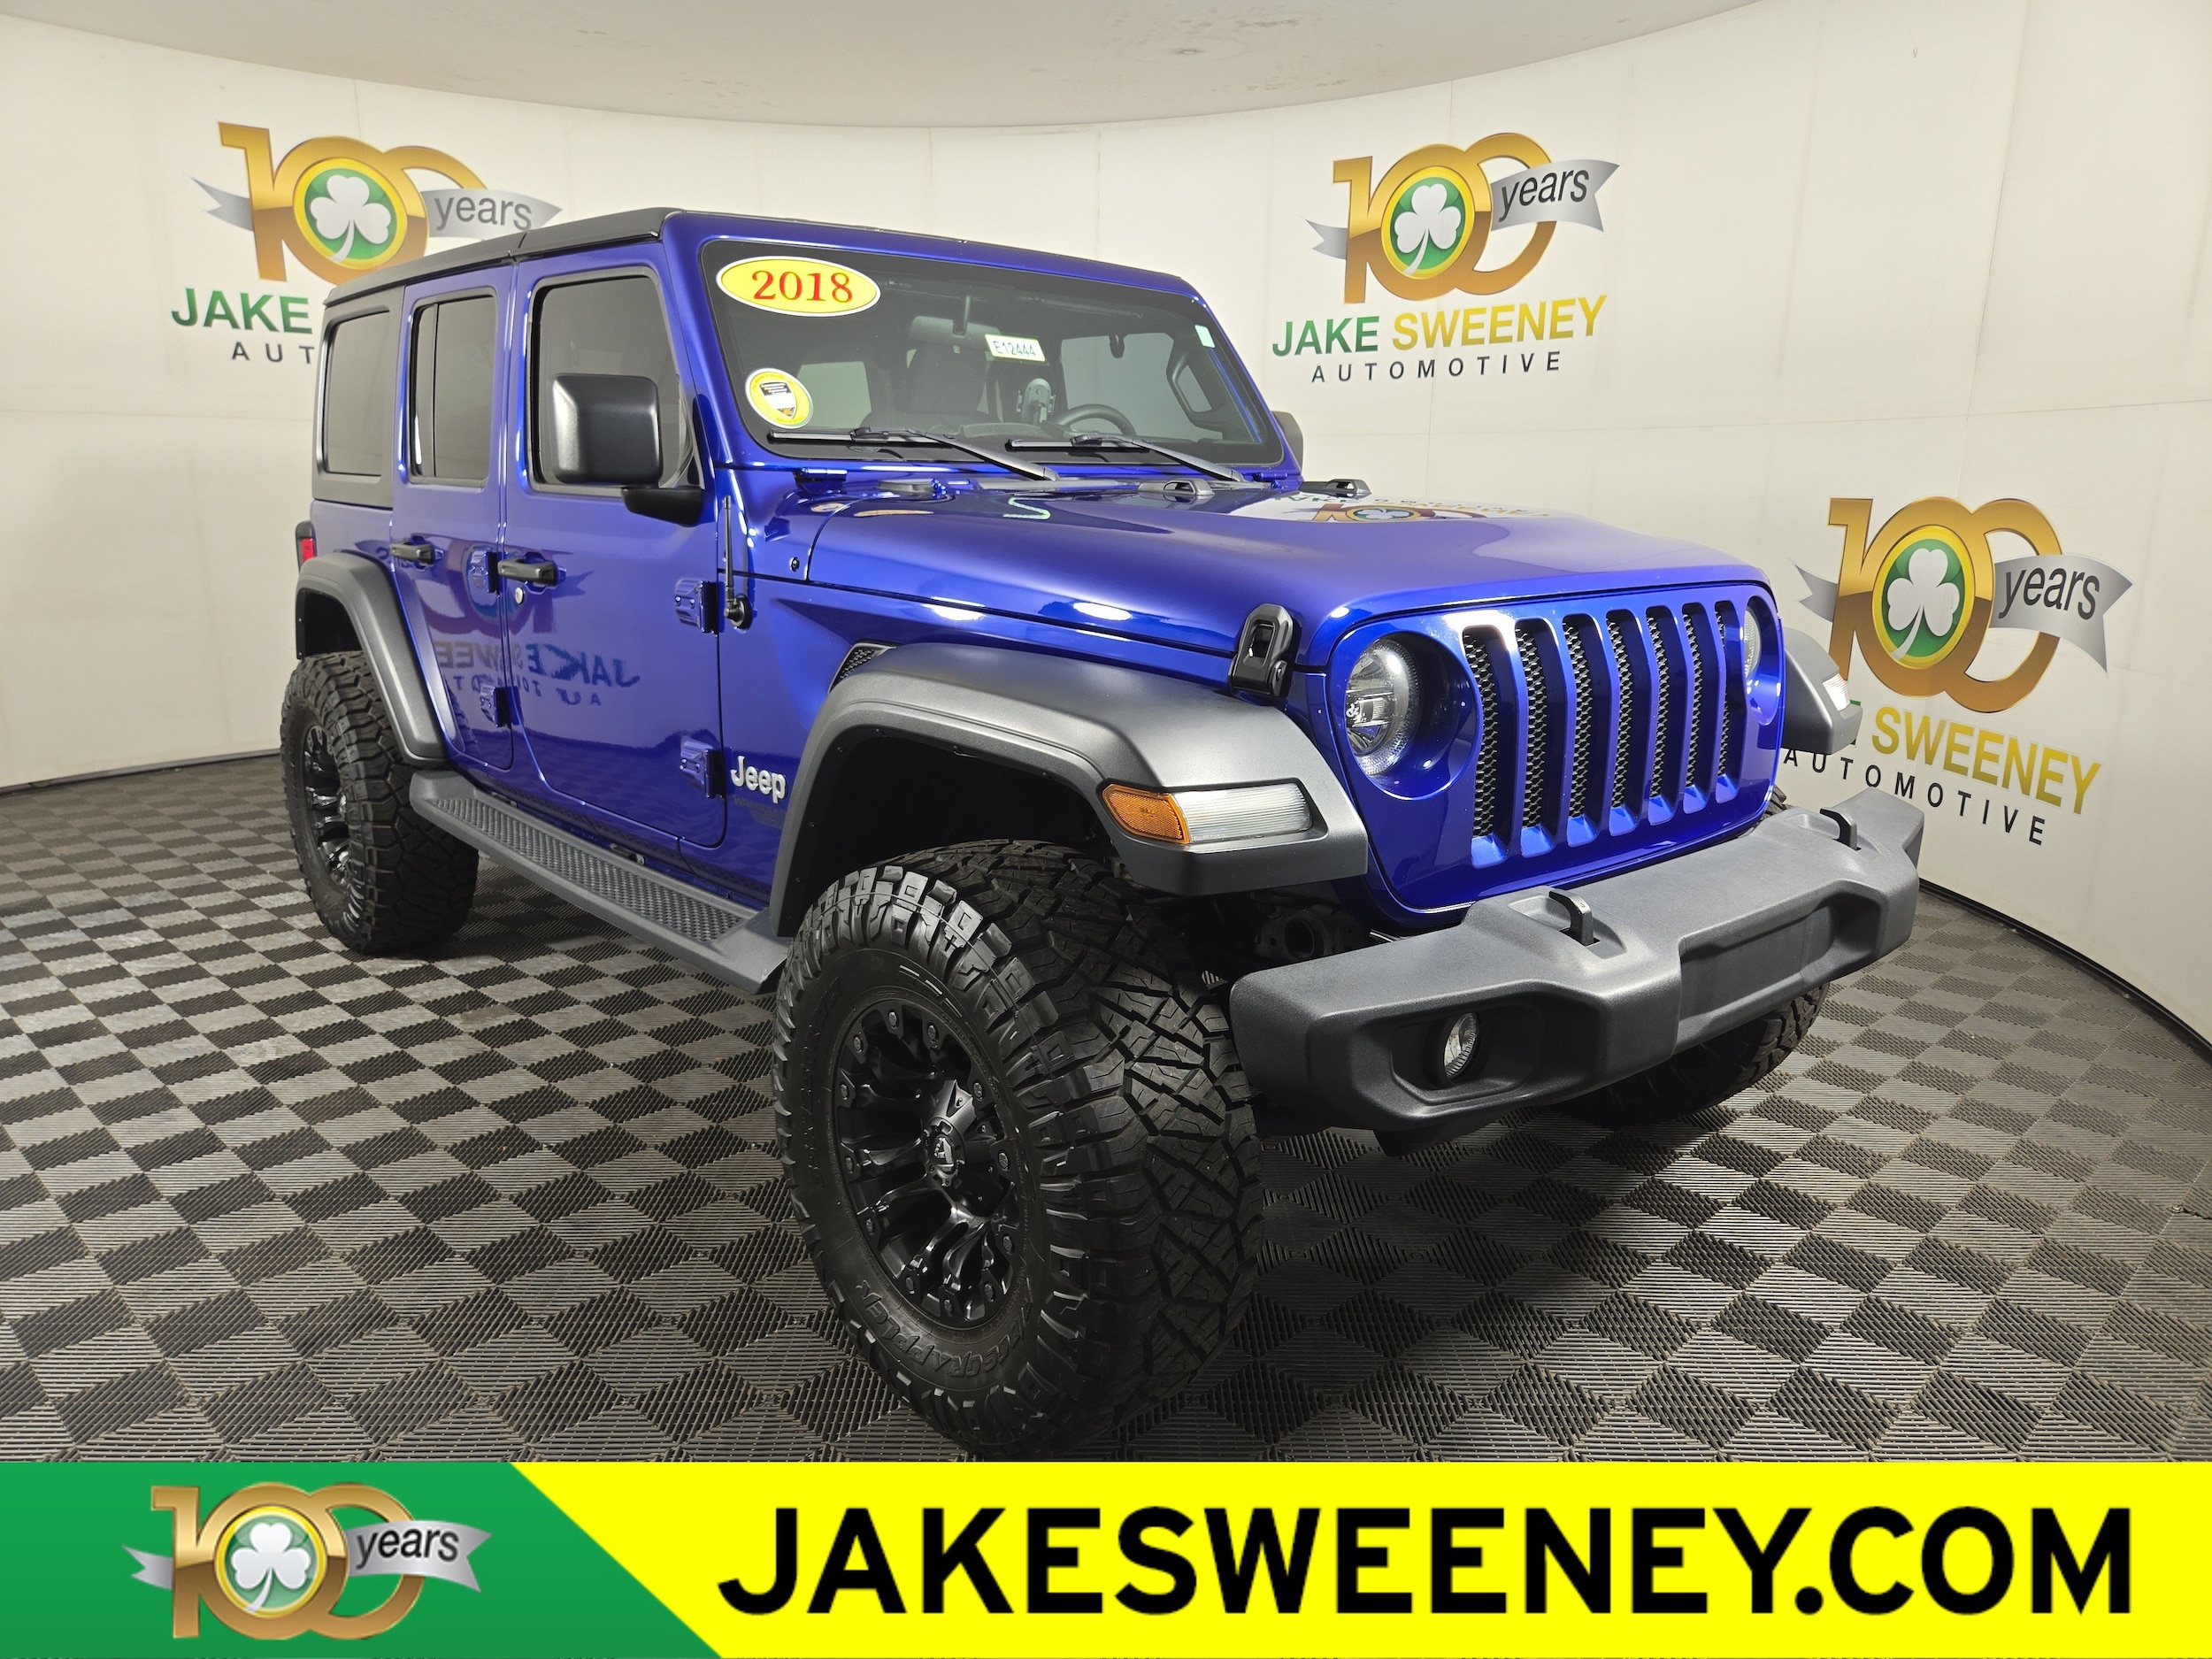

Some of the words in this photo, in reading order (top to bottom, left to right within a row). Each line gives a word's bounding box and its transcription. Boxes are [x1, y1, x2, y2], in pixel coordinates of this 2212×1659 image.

[434, 190, 532, 232] years
[1333, 132, 1556, 303] 100
[1499, 169, 1589, 222] years
[171, 288, 312, 334] JAKE
[751, 268, 855, 304] 2018
[1272, 316, 1379, 357] JAKE
[1392, 295, 1608, 350] SWEENEY
[1311, 351, 1561, 383] AUTOMOTIVE
[1827, 496, 2063, 713] 100
[1998, 566, 2101, 620] years
[730, 755, 787, 804] Jeep
[1871, 705, 2101, 815] SWEENEY
[1783, 749, 2046, 846] AUTOMOTIVE
